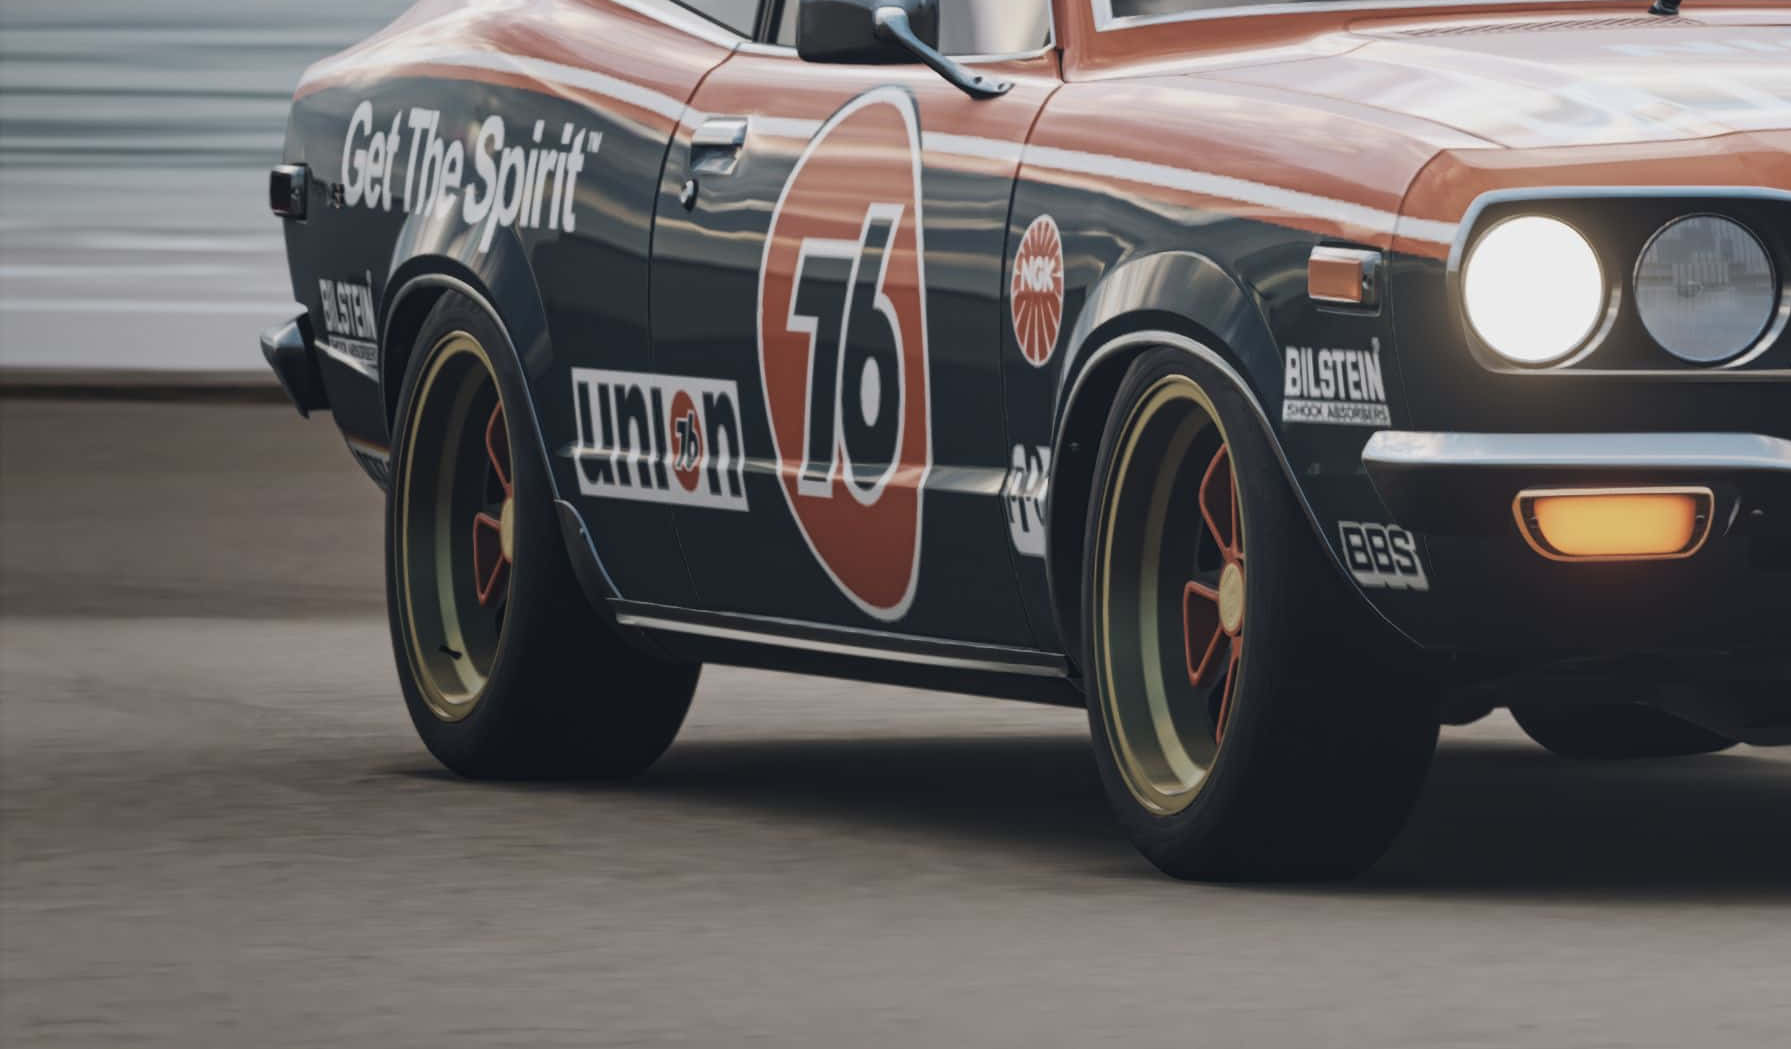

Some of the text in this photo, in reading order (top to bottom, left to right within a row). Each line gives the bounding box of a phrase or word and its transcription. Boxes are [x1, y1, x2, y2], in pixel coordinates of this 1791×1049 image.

[342, 100, 402, 212] Get
[403, 107, 464, 219] The
[319, 269, 378, 340] BILSTEIN
[1020, 255, 1056, 293] NGK
[786, 202, 906, 508] 76
[1284, 337, 1386, 402] BILSTEIN
[1339, 521, 1425, 587] BBS
